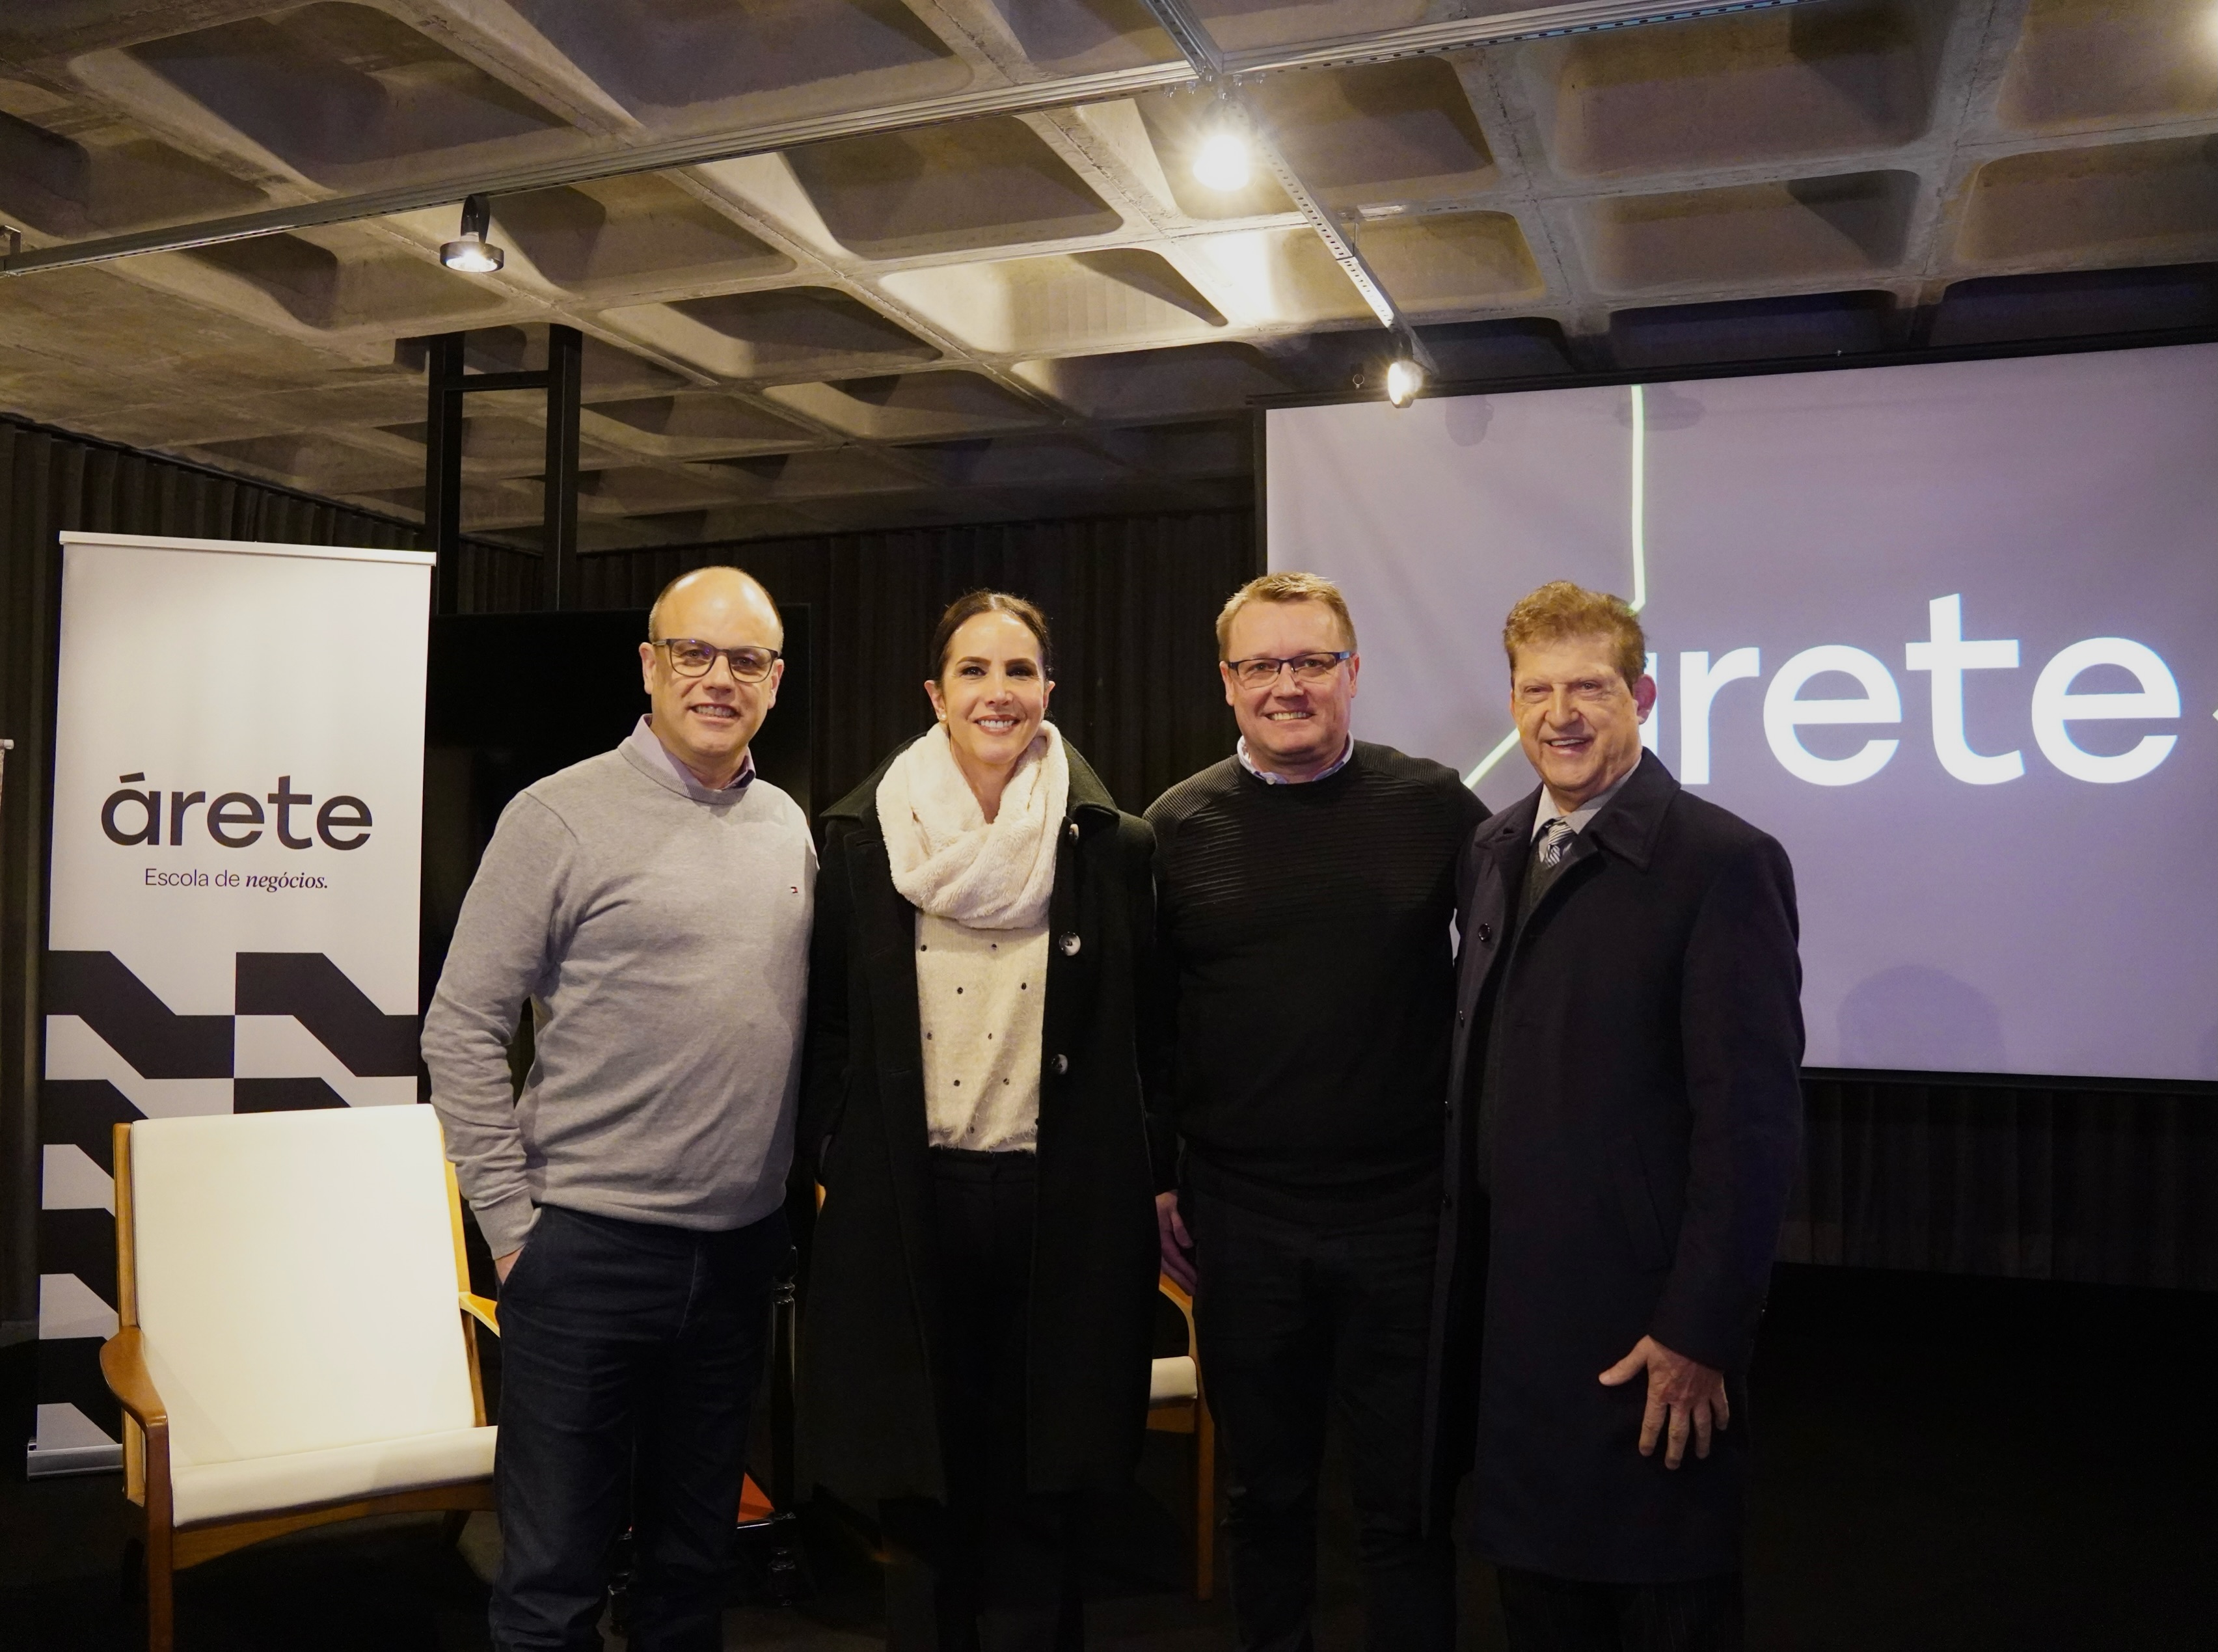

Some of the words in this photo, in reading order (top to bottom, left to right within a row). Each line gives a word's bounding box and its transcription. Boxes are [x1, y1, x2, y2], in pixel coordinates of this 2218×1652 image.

[1638, 593, 2181, 787] rete
[101, 772, 373, 851] árete
[145, 868, 209, 887] Escola
[215, 869, 240, 887] de
[245, 871, 328, 893] negócios.
